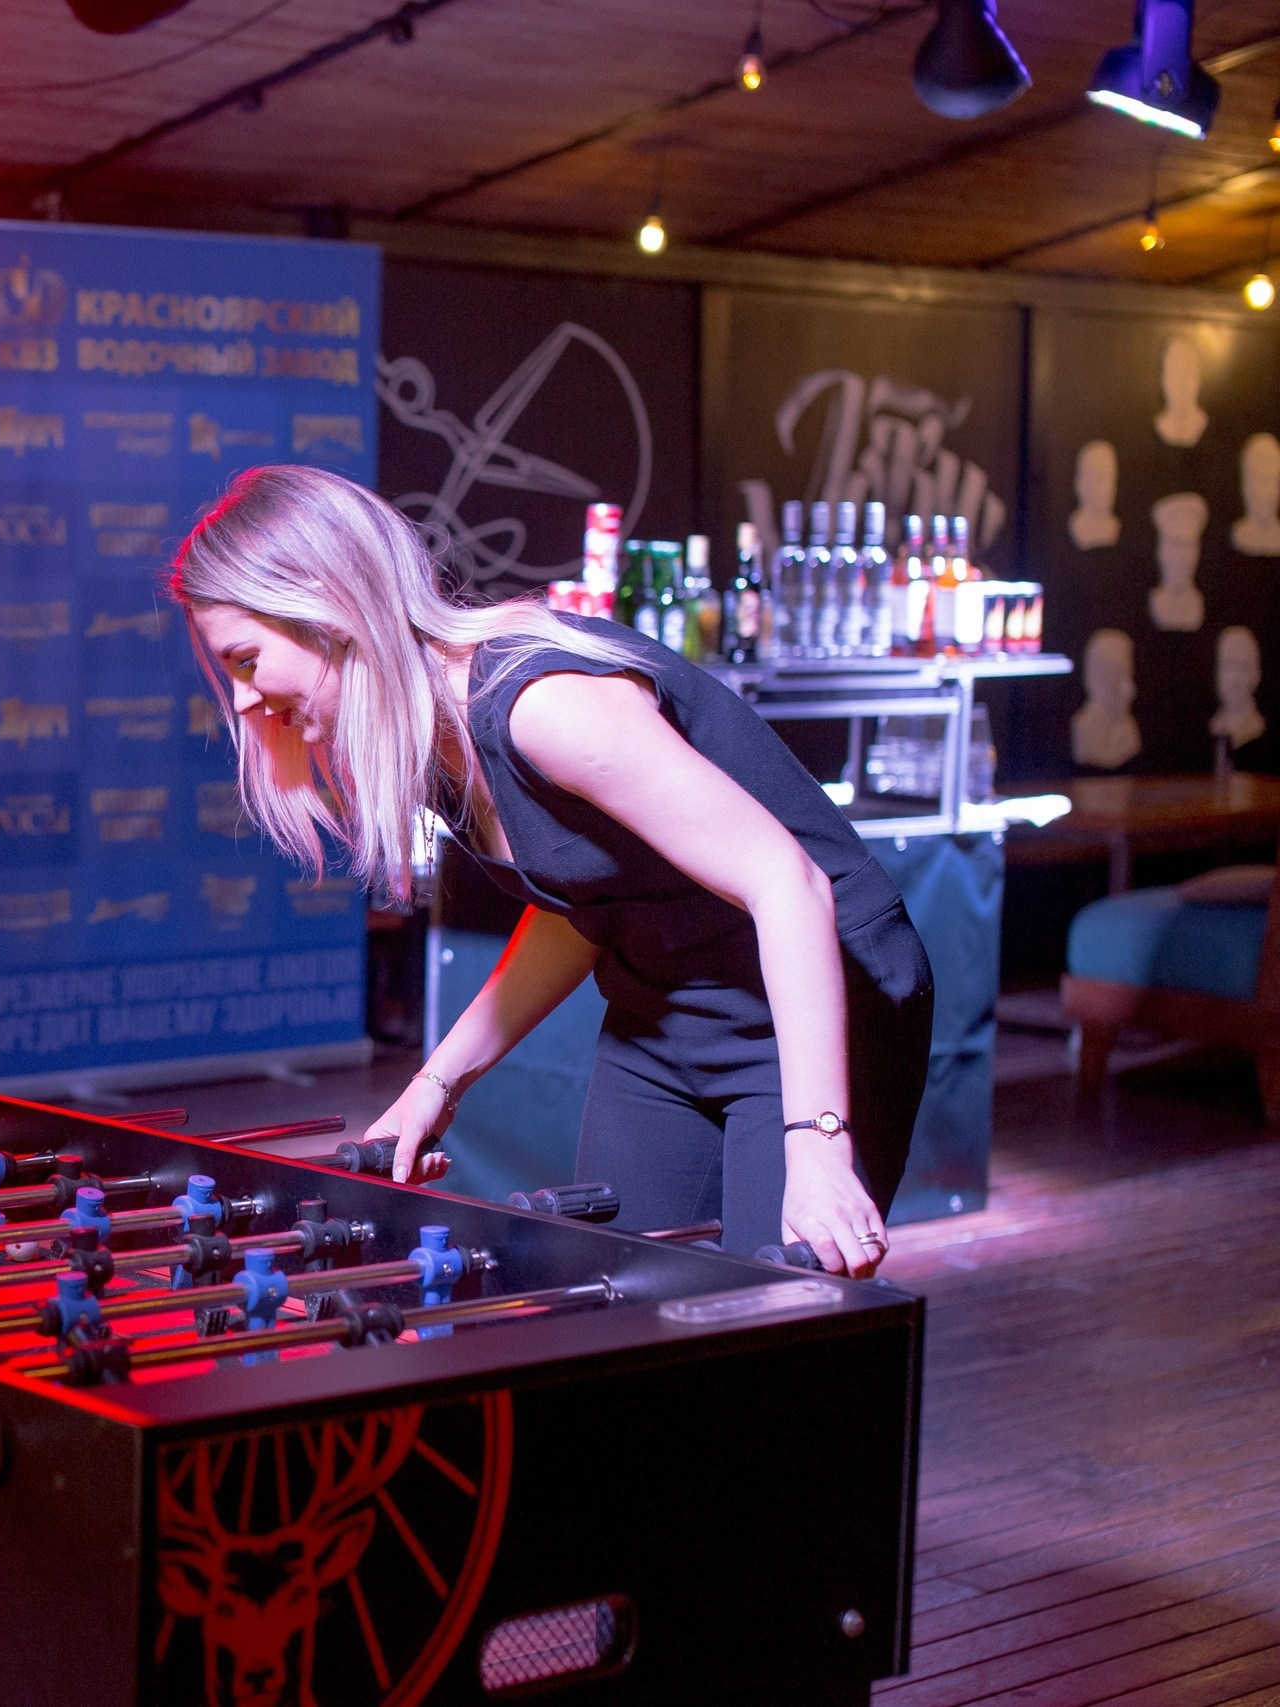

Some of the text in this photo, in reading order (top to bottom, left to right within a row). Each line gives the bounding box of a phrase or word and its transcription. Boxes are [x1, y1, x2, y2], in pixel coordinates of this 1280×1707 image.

[76, 289, 361, 338] КРАСНОЯРСКИЙ
[76, 337, 360, 387] ВОДОЧНЫЙ ЗАВОД
